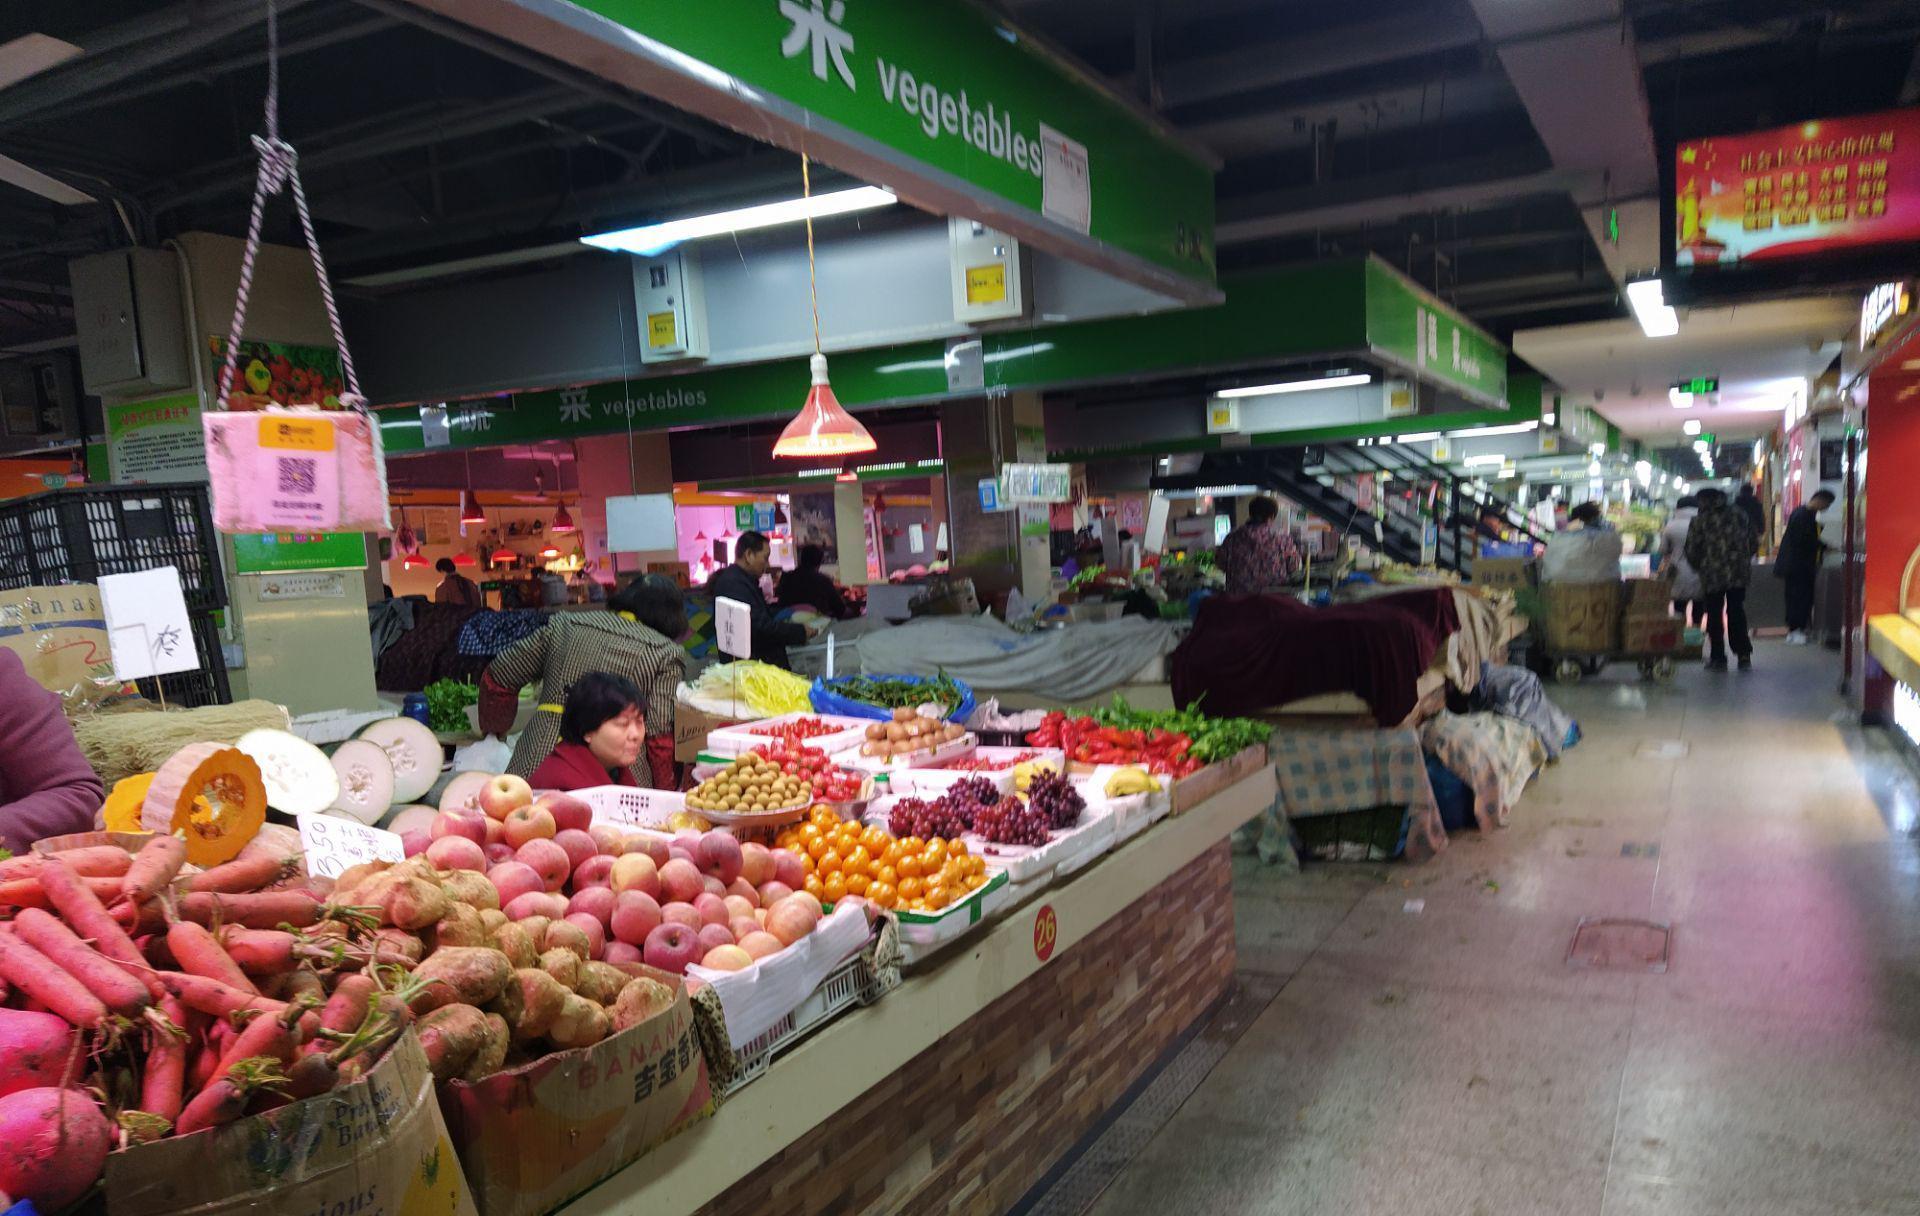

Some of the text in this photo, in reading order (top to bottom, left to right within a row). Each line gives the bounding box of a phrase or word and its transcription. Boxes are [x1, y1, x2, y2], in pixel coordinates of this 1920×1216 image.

[876, 57, 1043, 178] vegetables
[559, 386, 592, 423] 菜
[602, 388, 707, 418] vegetables
[1037, 911, 1055, 952] 26
[578, 1011, 685, 1090] BANANA
